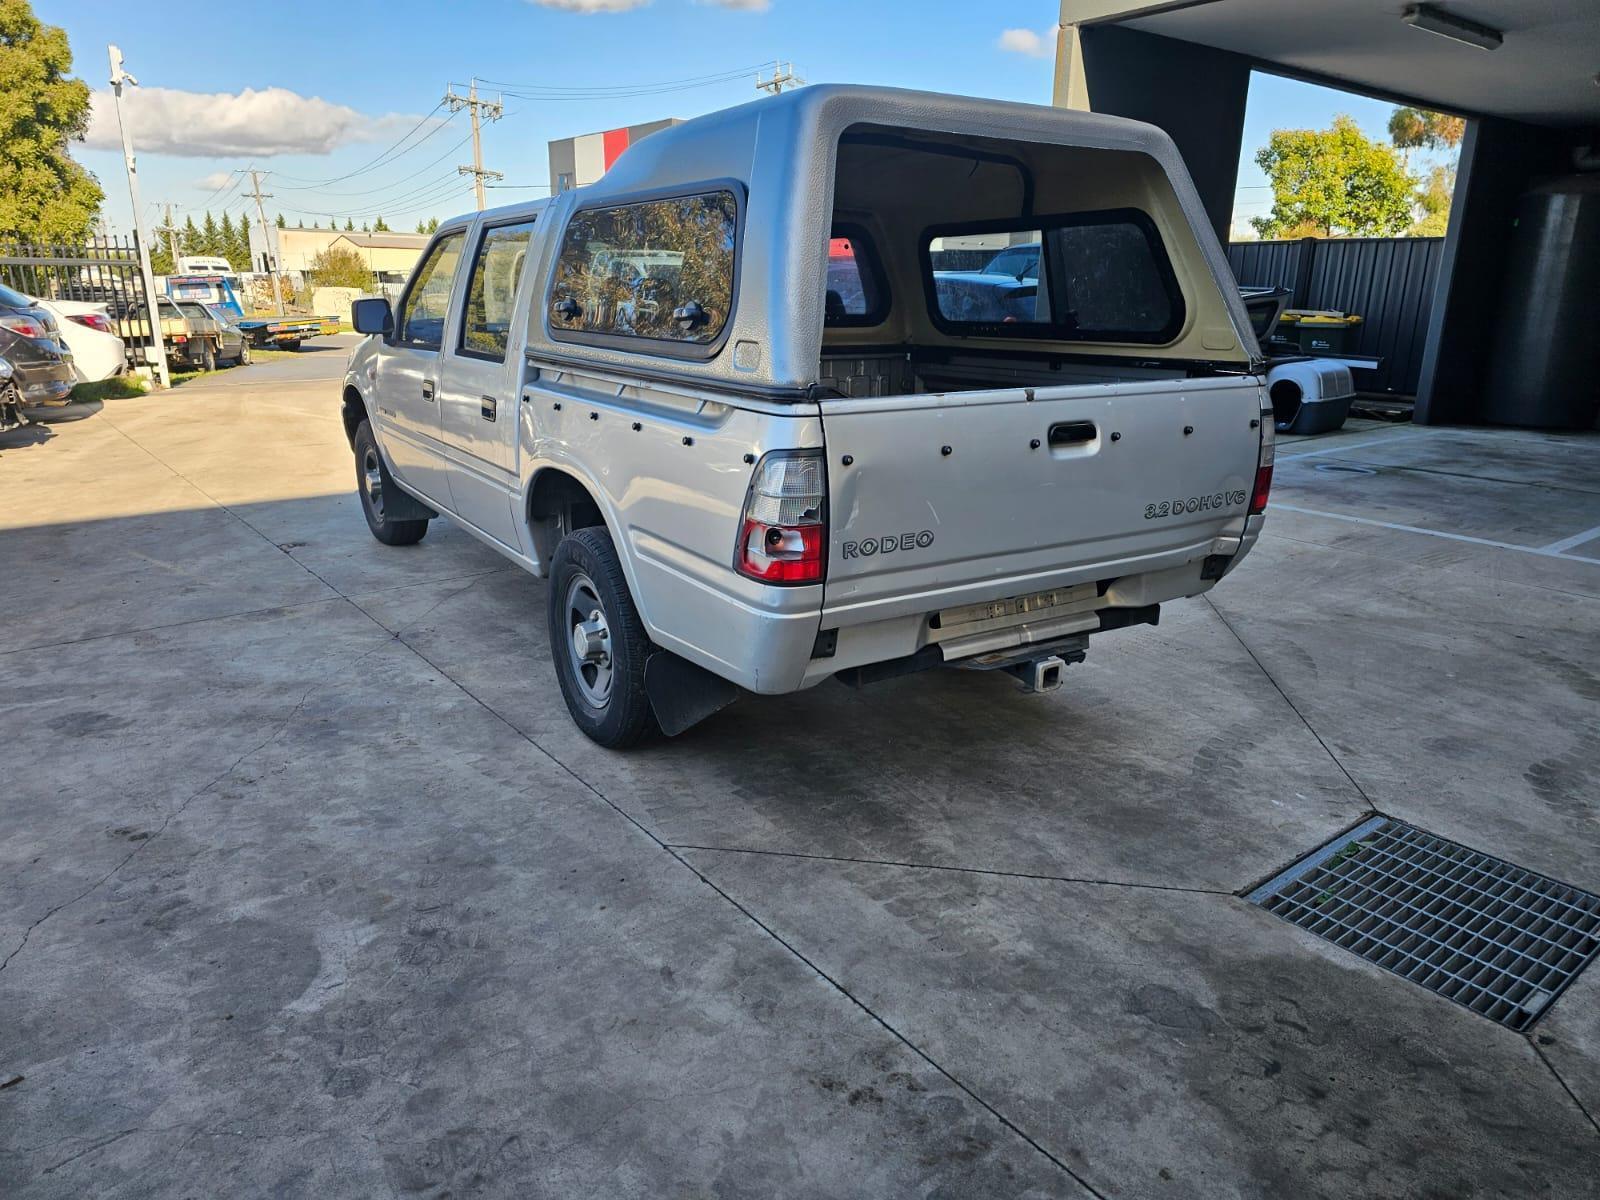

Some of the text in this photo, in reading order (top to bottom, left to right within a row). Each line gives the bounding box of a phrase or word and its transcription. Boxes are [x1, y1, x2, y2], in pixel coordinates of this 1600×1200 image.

[1144, 490, 1246, 519] 3.2 DOHC V6
[842, 530, 934, 560] RODEO
